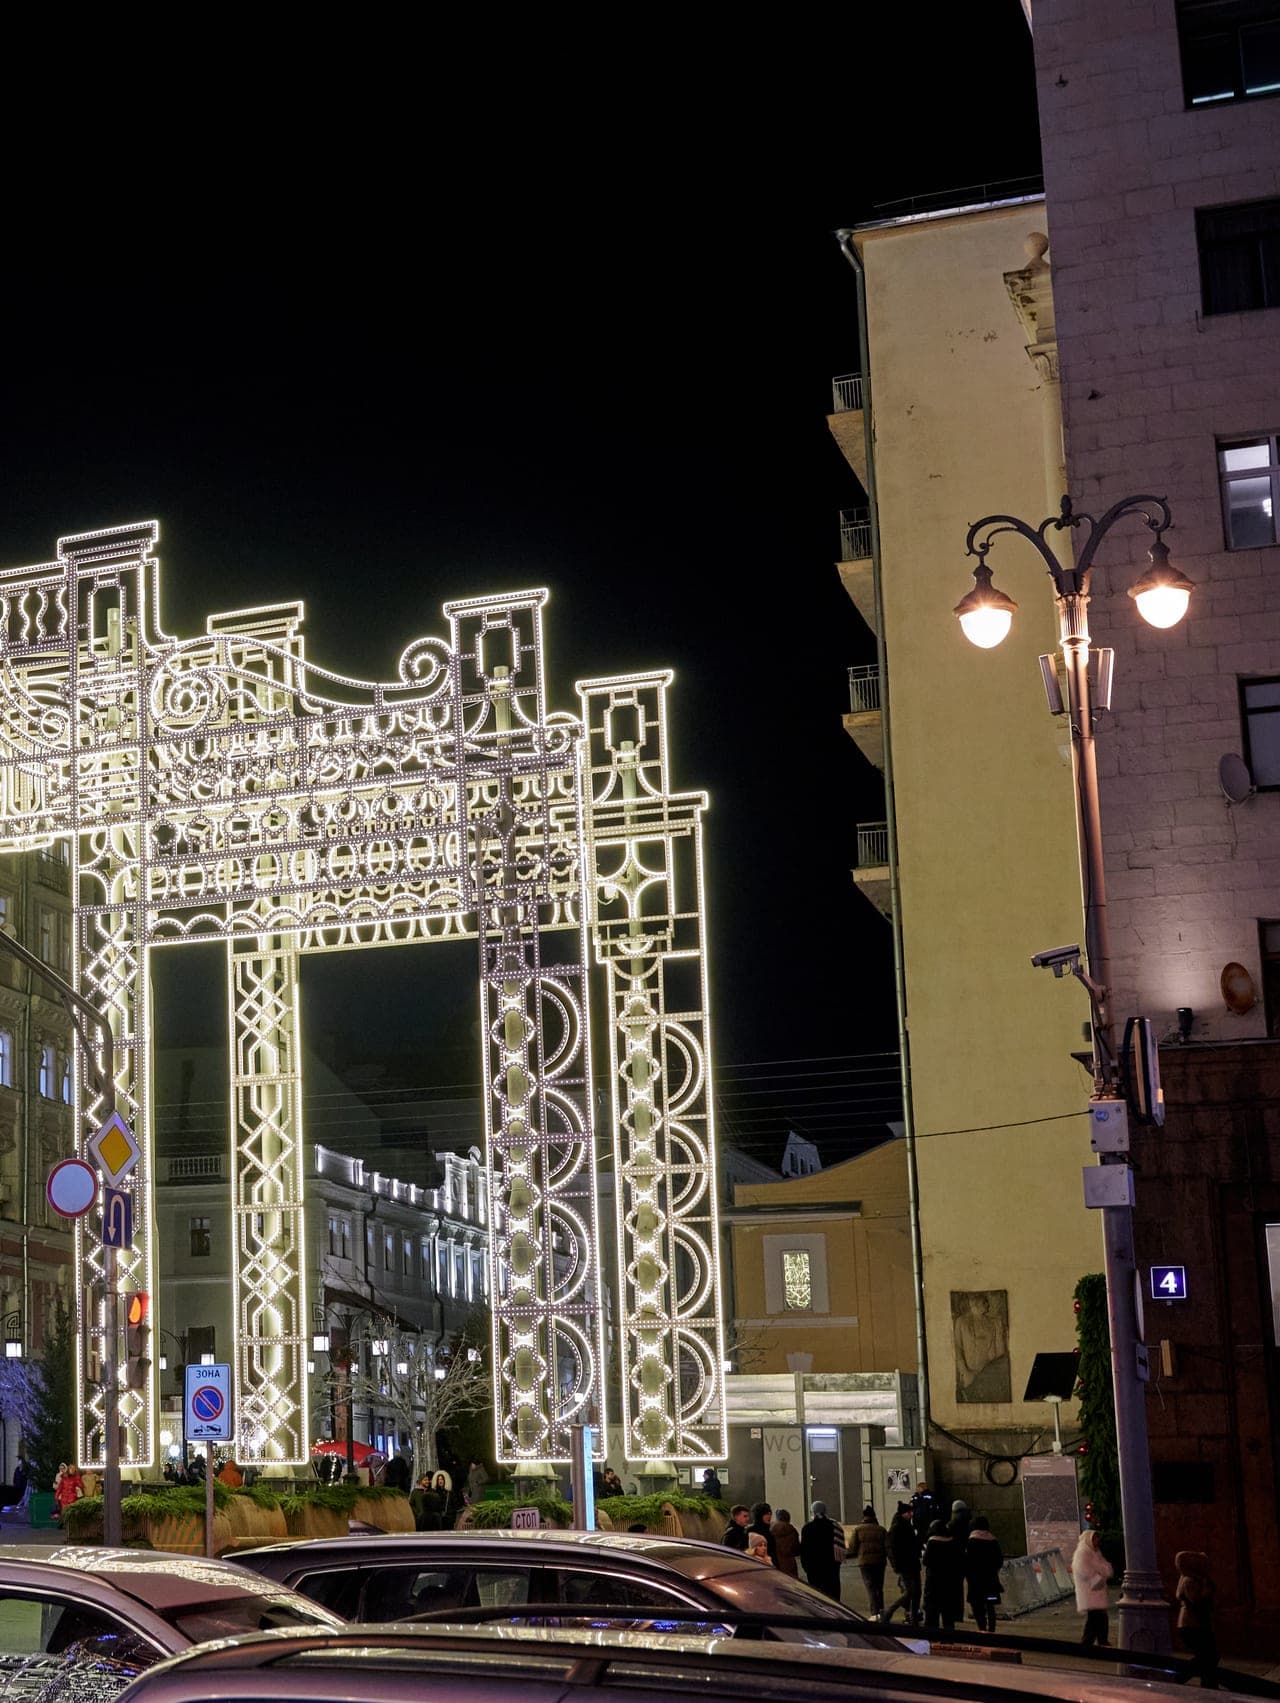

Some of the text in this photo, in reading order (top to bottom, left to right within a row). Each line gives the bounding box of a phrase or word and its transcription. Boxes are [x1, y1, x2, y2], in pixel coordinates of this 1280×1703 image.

[1160, 1271, 1177, 1293] 4
[195, 1369, 221, 1379] ЗОНА
[764, 1434, 801, 1452] WC
[515, 1511, 537, 1529] СТОП
